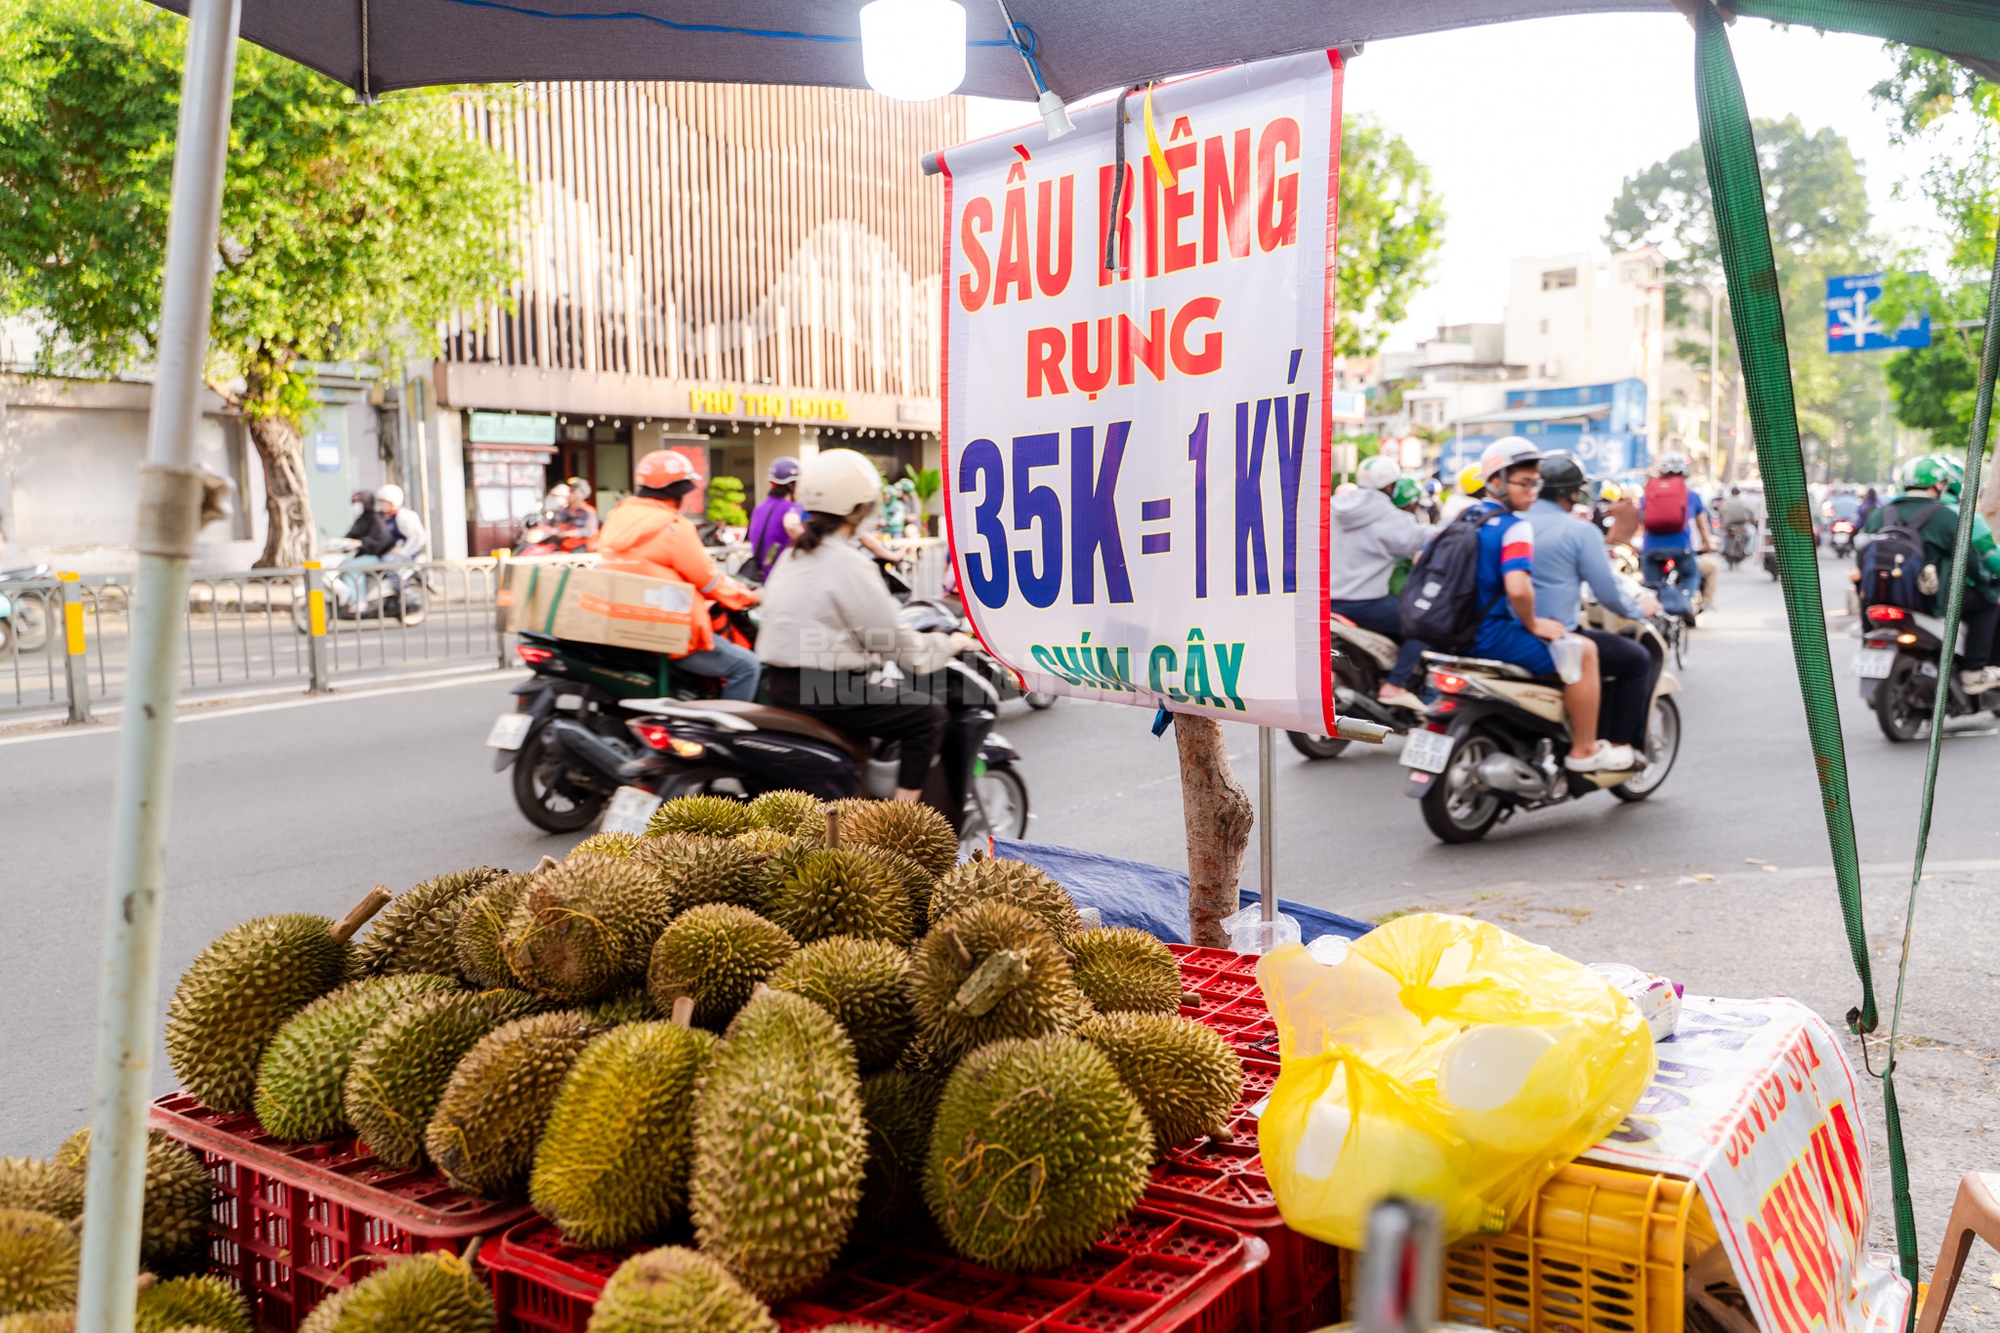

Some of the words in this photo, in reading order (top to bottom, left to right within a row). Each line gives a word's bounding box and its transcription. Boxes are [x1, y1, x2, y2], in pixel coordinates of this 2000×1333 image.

[959, 143, 1075, 313] SẦU
[1098, 115, 1301, 288] RIÊNG
[1026, 297, 1224, 402] RỤNG
[690, 385, 735, 414] PHÚ
[742, 393, 785, 421] THỌ
[791, 397, 849, 421] HOTEL
[1234, 347, 1311, 597] KÝ
[1030, 631, 1137, 693] CHÍN
[1148, 627, 1247, 712] CÂY
